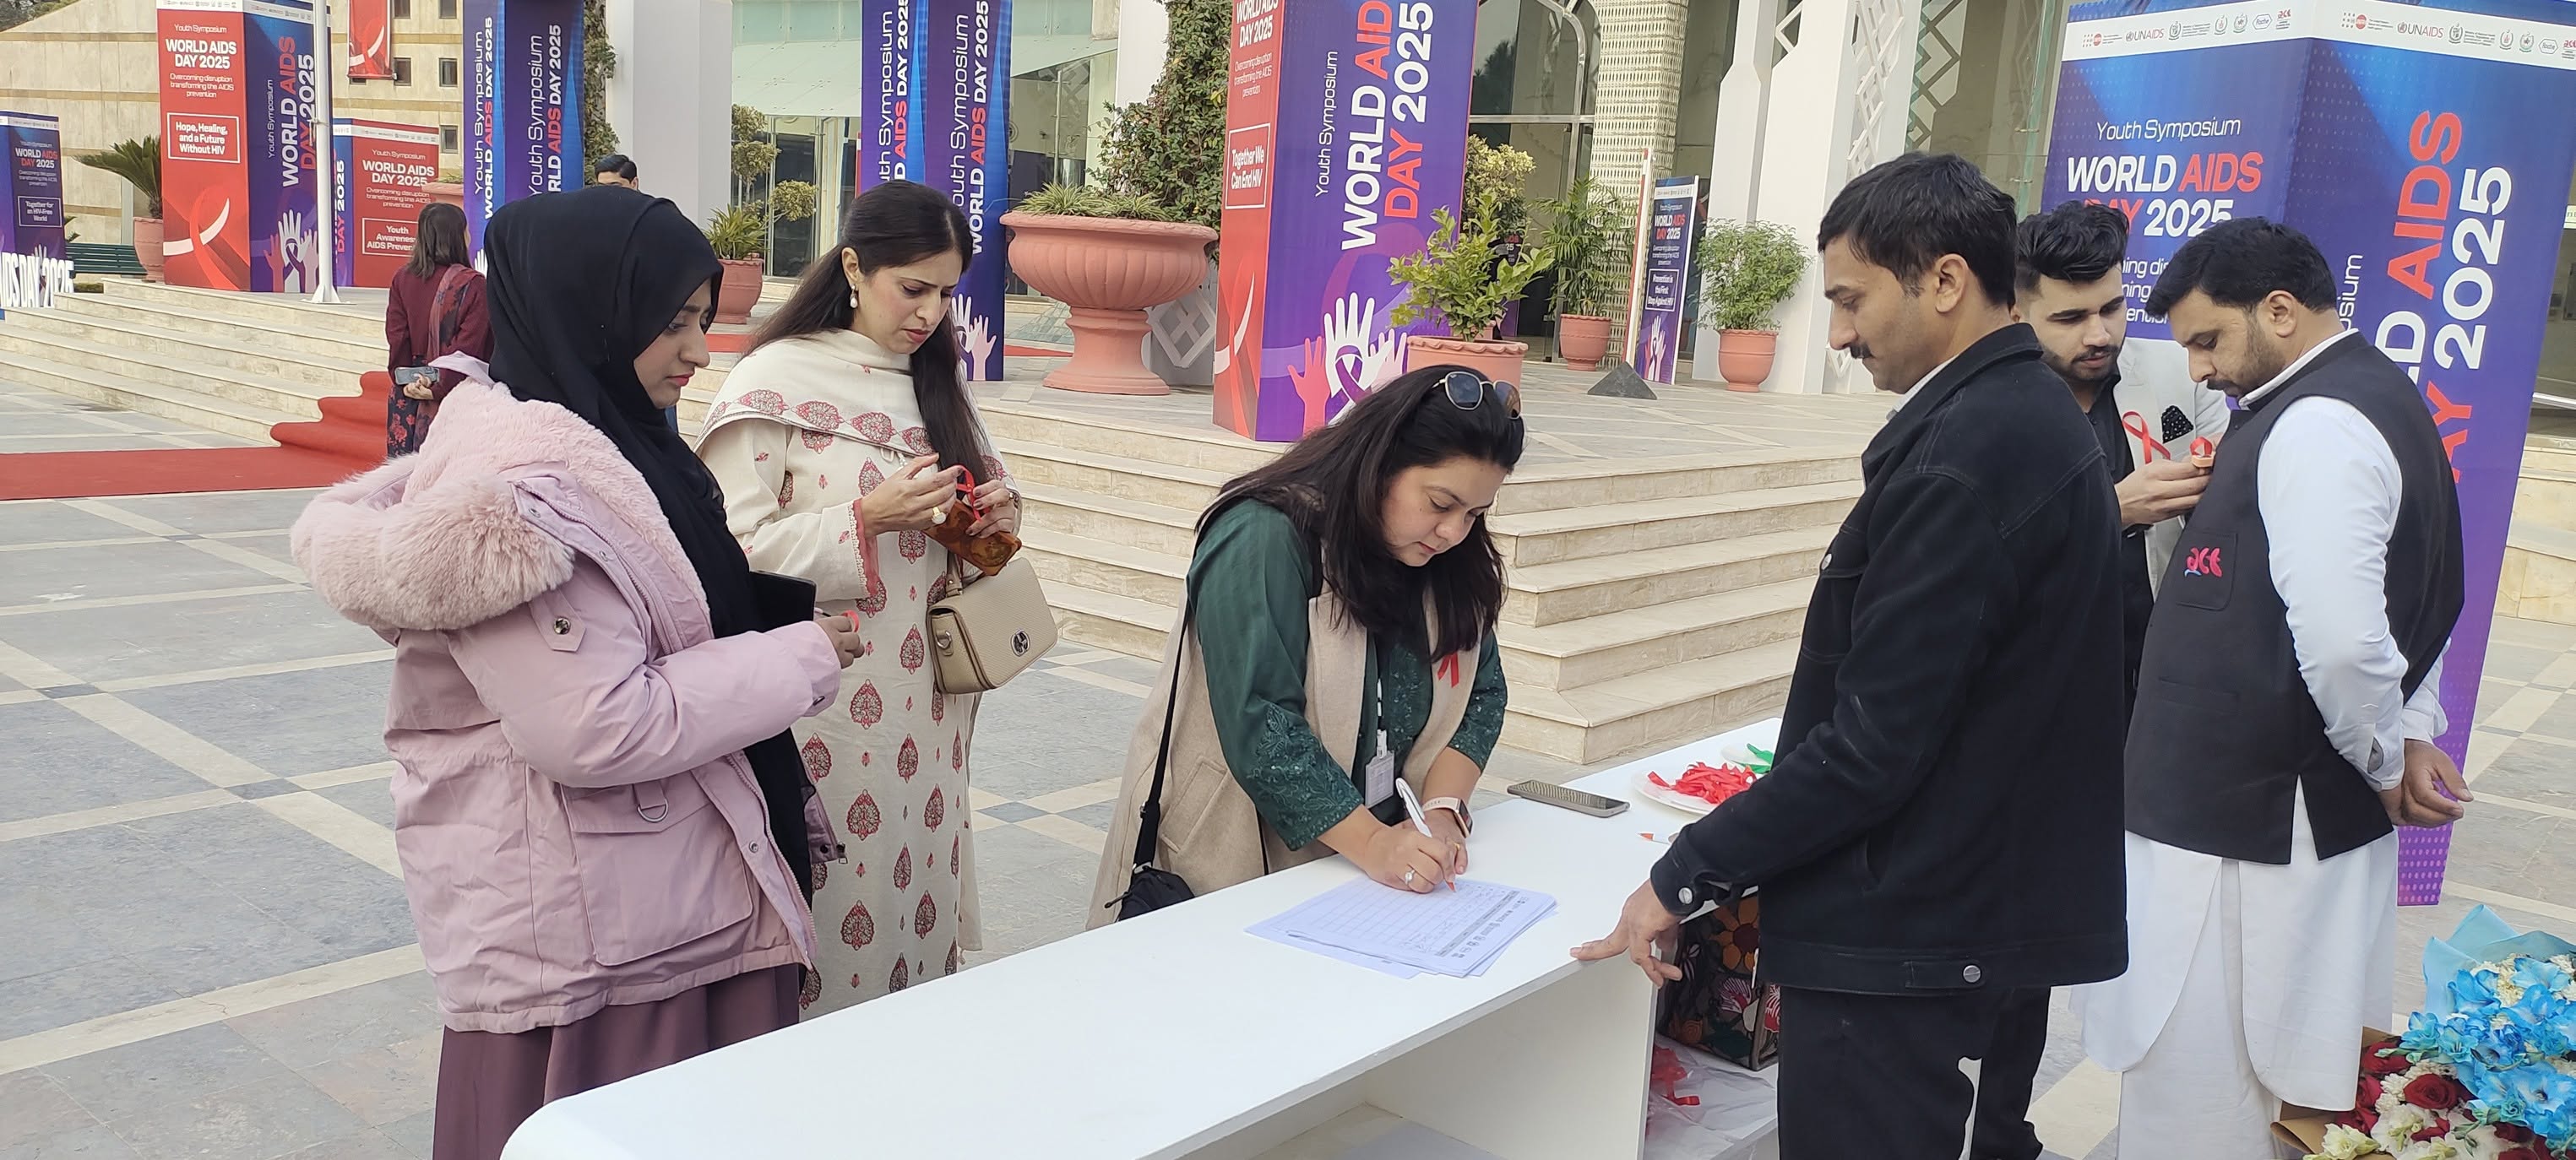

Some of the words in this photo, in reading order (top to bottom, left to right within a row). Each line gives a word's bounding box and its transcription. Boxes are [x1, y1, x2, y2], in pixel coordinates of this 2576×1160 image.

[174, 24, 192, 32] Youth
[193, 24, 227, 34] Symposium
[976, 0, 989, 58] 2025
[1236, 0, 1261, 24] WORLD
[1240, 22, 1254, 48] DAY
[1253, 14, 1273, 43] 2025
[2407, 24, 2444, 39] UNAIDS
[166, 39, 208, 53] WORLD
[209, 41, 236, 54] AIDS
[485, 17, 493, 62] 2025
[549, 24, 562, 70] 2025
[2133, 28, 2165, 41] UNAIDS
[175, 54, 198, 68] DAY
[199, 56, 231, 69] 2025
[279, 36, 296, 95] AIDS
[474, 31, 484, 136] Symposium
[485, 67, 493, 98] DAY
[879, 11, 894, 146] Symposium
[897, 53, 907, 96] DAY
[951, 14, 970, 150] Symposium
[974, 62, 987, 103] DAY
[1392, 2, 1434, 123] 2025
[266, 79, 275, 131] Symposium
[298, 54, 316, 118] 2025
[528, 35, 546, 141] Symposium
[549, 72, 562, 106] DAY
[1318, 51, 1338, 146] Symposium
[176, 122, 198, 133] Hope,
[179, 133, 193, 142] and
[199, 134, 226, 144] Future
[280, 98, 300, 187] WORLD
[484, 100, 493, 147] AIDS
[548, 107, 562, 154] AIDS
[894, 100, 907, 160] AIDS
[970, 107, 986, 165] AIDS
[2096, 121, 2142, 141] Youth
[2144, 117, 2241, 142] Symposium
[15, 148, 41, 158] WORLD
[41, 150, 58, 160] AIDS
[21, 158, 35, 167] DAY
[36, 160, 55, 168] 2025
[179, 144, 211, 154] Without
[212, 145, 225, 154] HIV
[362, 160, 405, 174] WORLD
[407, 165, 435, 176] AIDS
[372, 149, 391, 158] Youth
[475, 141, 483, 194] Youth
[528, 144, 543, 198] Youth
[1231, 148, 1255, 171] Together
[1255, 144, 1264, 165] We
[1341, 84, 1386, 251] WORLD
[337, 160, 345, 211] 2025
[372, 173, 395, 184] DAY
[397, 176, 427, 187] 2025
[485, 149, 493, 220] WORLD
[1231, 171, 1241, 189] Can
[1242, 170, 1252, 188] End
[1252, 168, 1263, 187] HIV
[1315, 148, 1332, 198] Youth
[1384, 127, 1423, 219] DAY
[2068, 154, 2177, 193] WORLD
[2177, 151, 2264, 192] AIDS
[969, 168, 984, 255] WORLD
[1655, 214, 1672, 227] WORLD
[1672, 214, 1687, 226] AIDS
[2144, 199, 2234, 237] 2025
[2387, 111, 2462, 300] AIDS
[367, 241, 386, 249] AIDS
[386, 225, 409, 234] Youth
[1656, 228, 1666, 240] DAY
[1666, 228, 1681, 240] 2025
[19, 254, 41, 308] DAY
[2432, 166, 2512, 371] 2025
